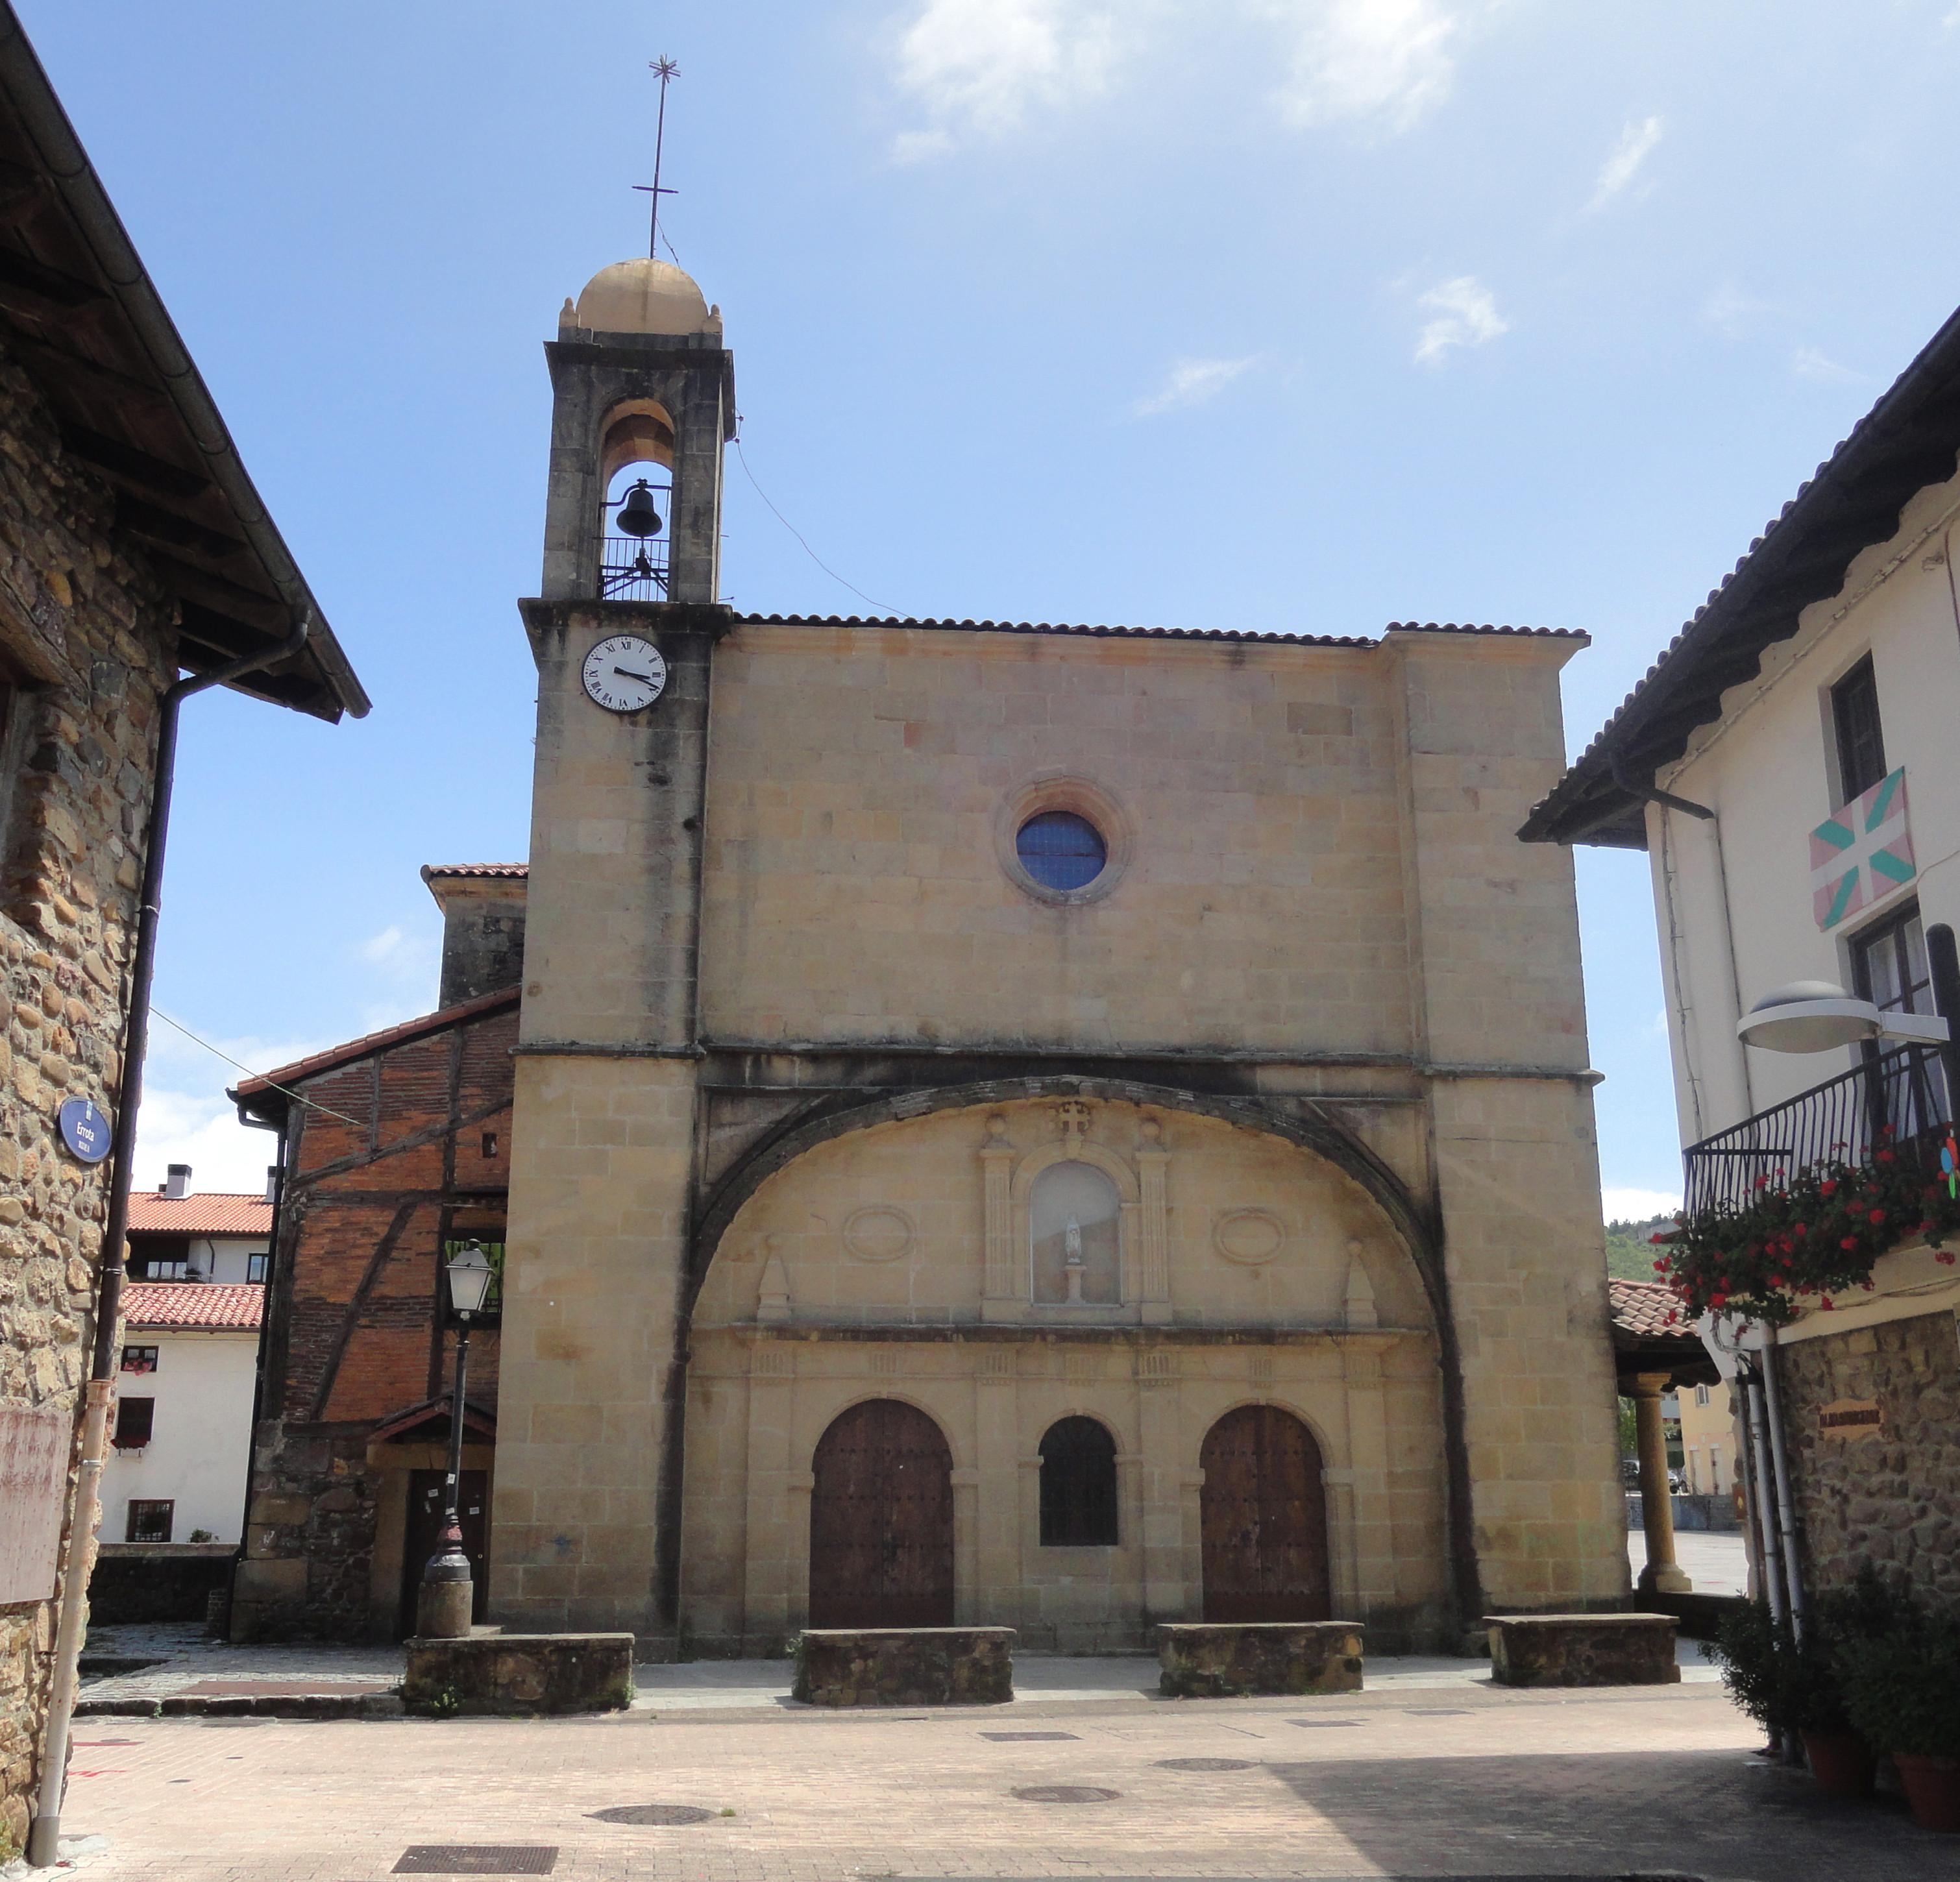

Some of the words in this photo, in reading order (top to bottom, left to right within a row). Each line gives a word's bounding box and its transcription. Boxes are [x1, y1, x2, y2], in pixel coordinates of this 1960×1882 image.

[605, 644, 615, 654] XI
[620, 641, 631, 650] XII
[639, 645, 645, 654] I
[593, 655, 604, 664] X
[589, 669, 598, 678] IX
[591, 681, 602, 694] VIII
[602, 692, 613, 703] VII
[619, 698, 628, 707] VI
[77, 1121, 95, 1142] Errota
